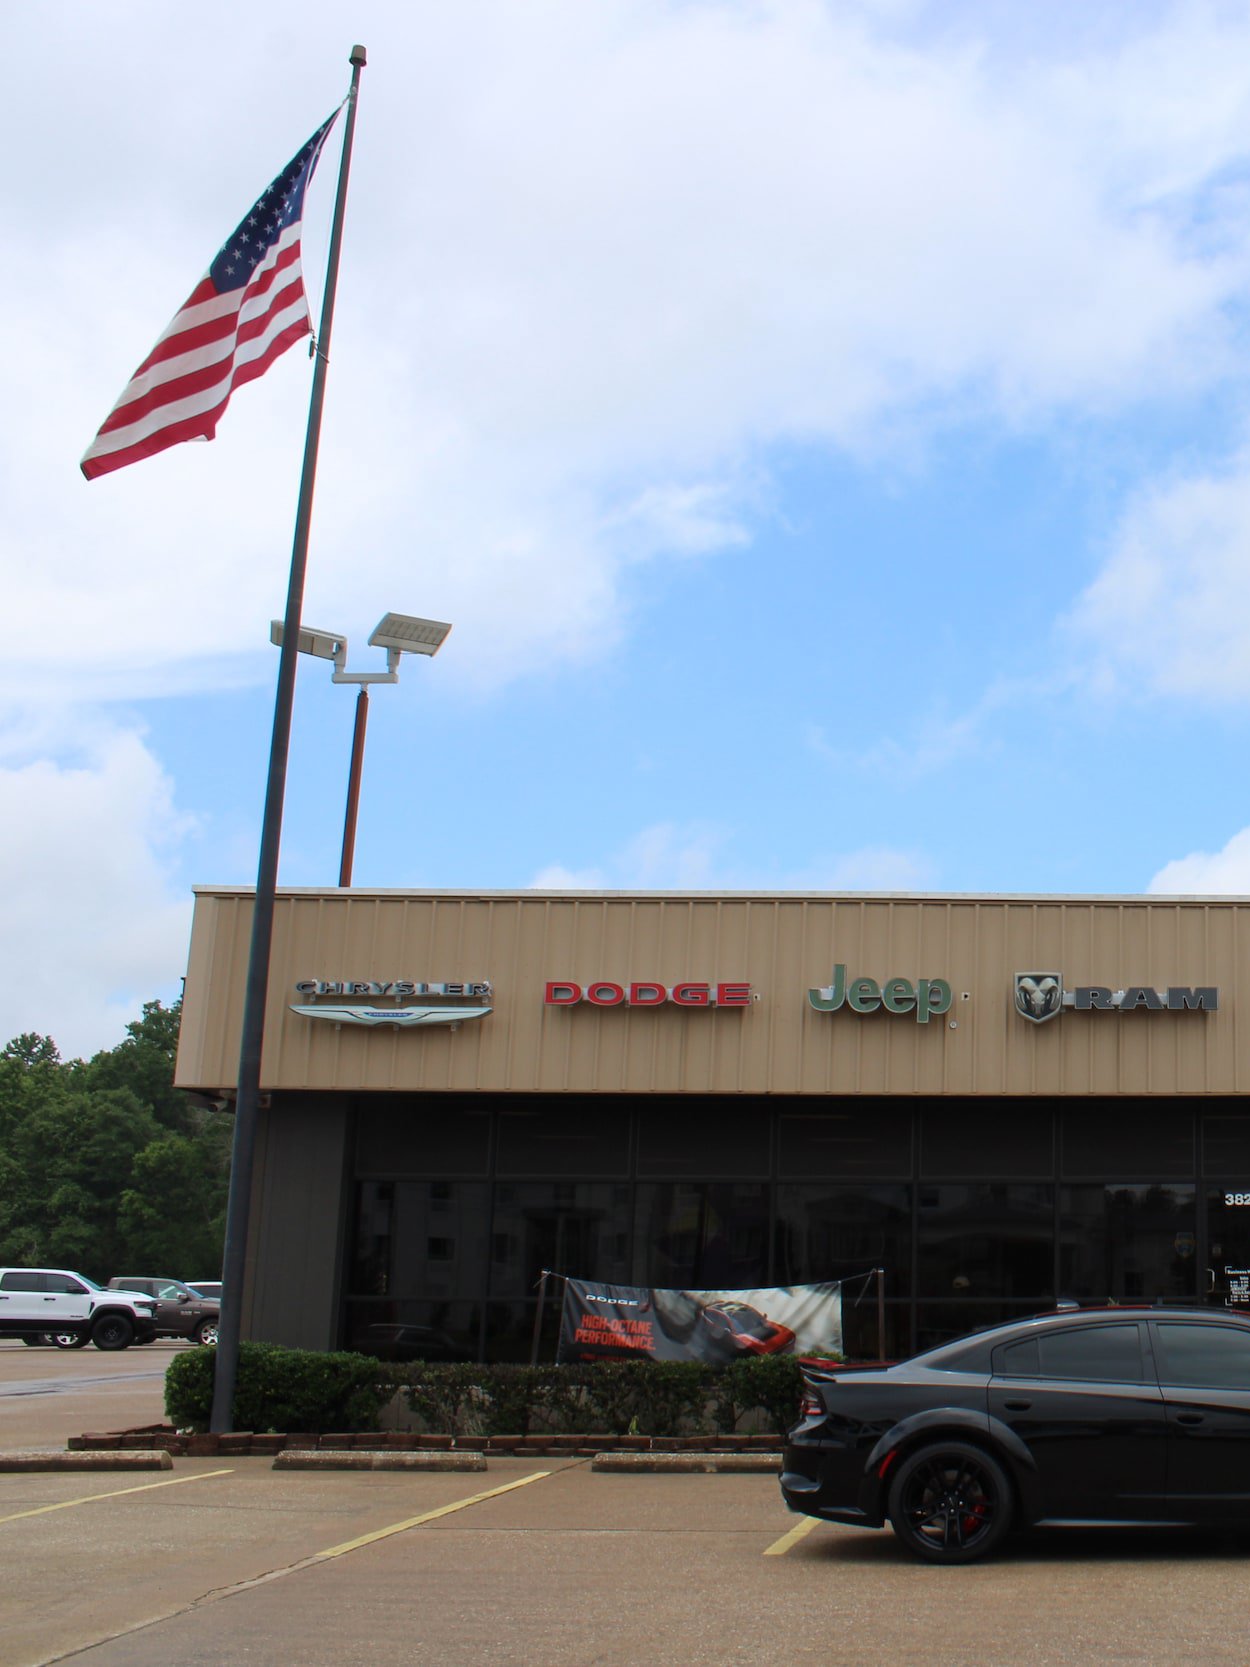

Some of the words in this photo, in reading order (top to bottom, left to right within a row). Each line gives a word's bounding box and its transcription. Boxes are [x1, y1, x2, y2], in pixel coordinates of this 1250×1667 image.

[296, 980, 492, 997] CHRYSLER
[545, 981, 752, 1007] DODGE
[809, 964, 952, 1023] Jeep
[1074, 986, 1219, 1010] RAM
[586, 1294, 639, 1306] DODGE
[582, 1314, 653, 1335] HIGH-OCTANE
[575, 1328, 656, 1351] PERFORMANCE.
